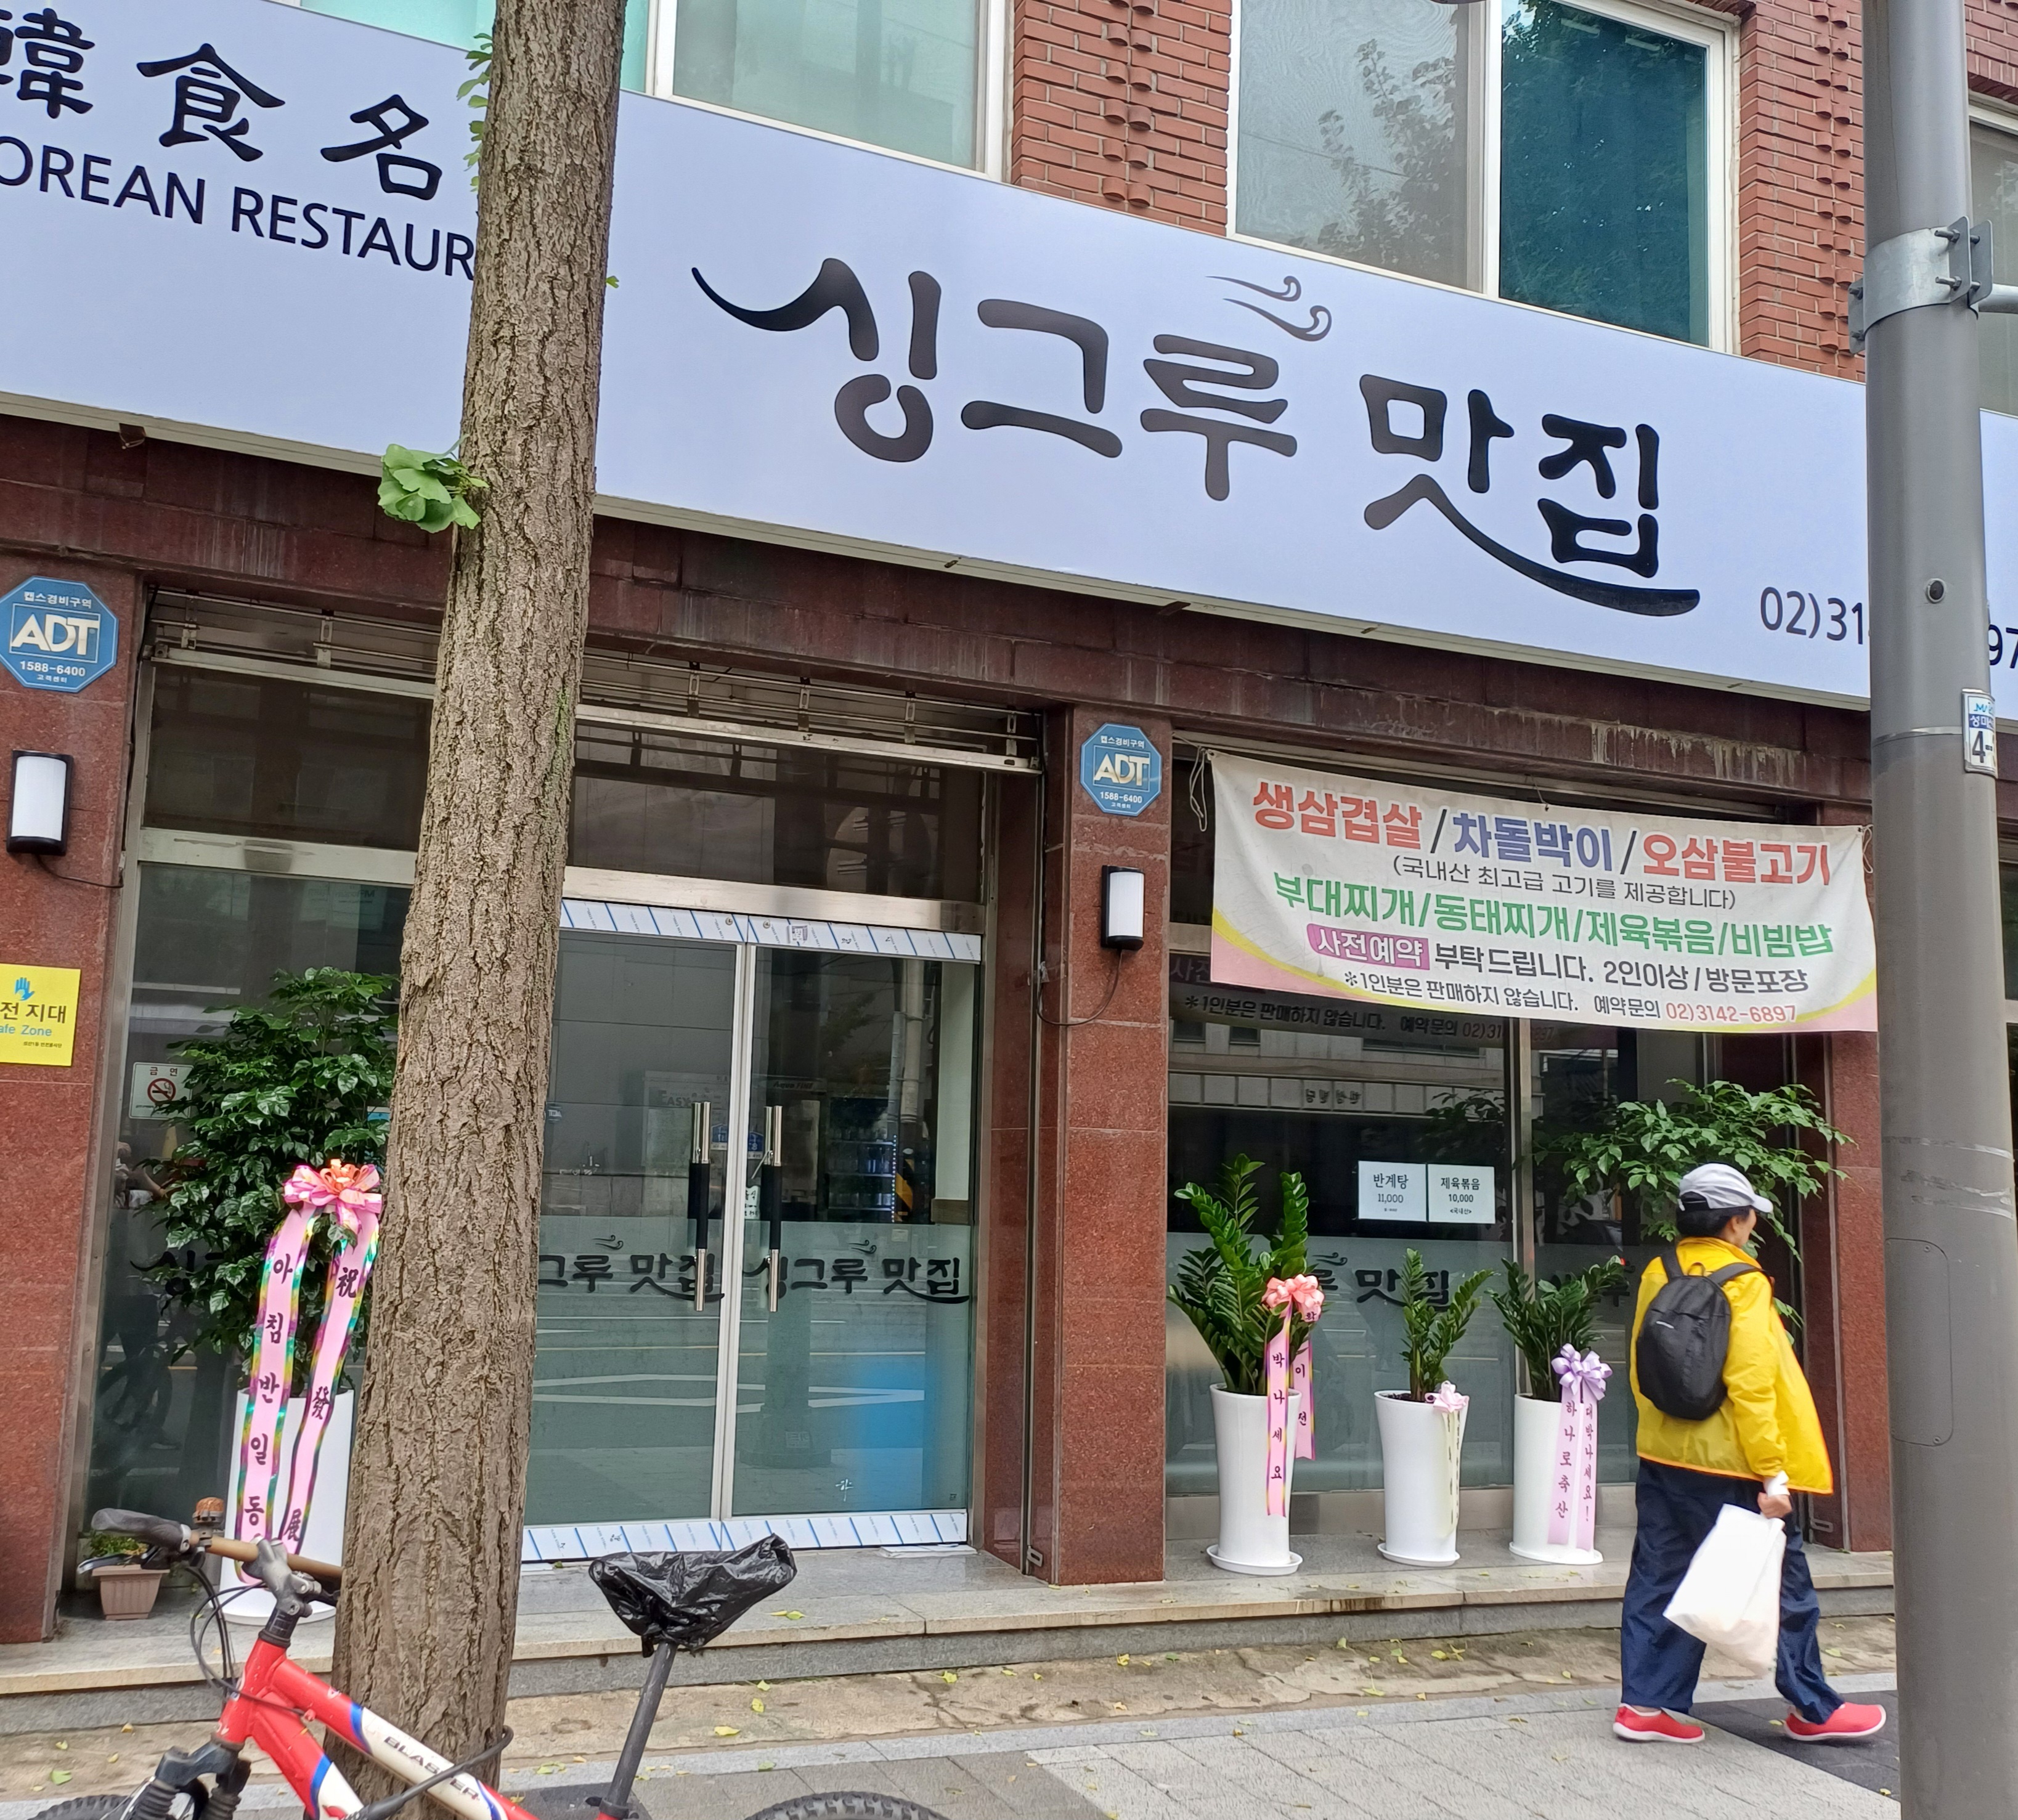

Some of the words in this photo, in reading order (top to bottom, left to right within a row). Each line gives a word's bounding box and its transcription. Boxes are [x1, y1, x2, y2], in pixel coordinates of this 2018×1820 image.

[691, 258, 1298, 501] 싱그루
[1359, 373, 1700, 616] 맛집
[10, 614, 100, 656] ADT
[20, 660, 86, 677] 1588-6400
[1094, 754, 1150, 786] ADT
[1100, 791, 1142, 803] 1588-6400
[1393, 855, 1470, 884] (국내산
[1478, 865, 1544, 892] 최고급
[1552, 873, 1616, 900] 고기를
[1624, 881, 1736, 910] 제공합니다)
[1317, 928, 1423, 967] 사전예약
[25, 1004, 67, 1024] 지대
[1426, 980, 1500, 1005] 판매하지
[1503, 986, 1579, 1012] 않습니다.
[1593, 994, 1661, 1018] 예약문의
[1666, 1002, 1796, 1022] 02)3142-6897
[20, 1025, 52, 1036] Zone
[1373, 1173, 1409, 1190] 반계탕
[1441, 1177, 1481, 1190] 제육볶음
[1378, 1193, 1404, 1204] 11,000
[1449, 1194, 1474, 1203] 10,000
[882, 1256, 970, 1304] 맛집
[383, 1736, 480, 1800] BLASER
